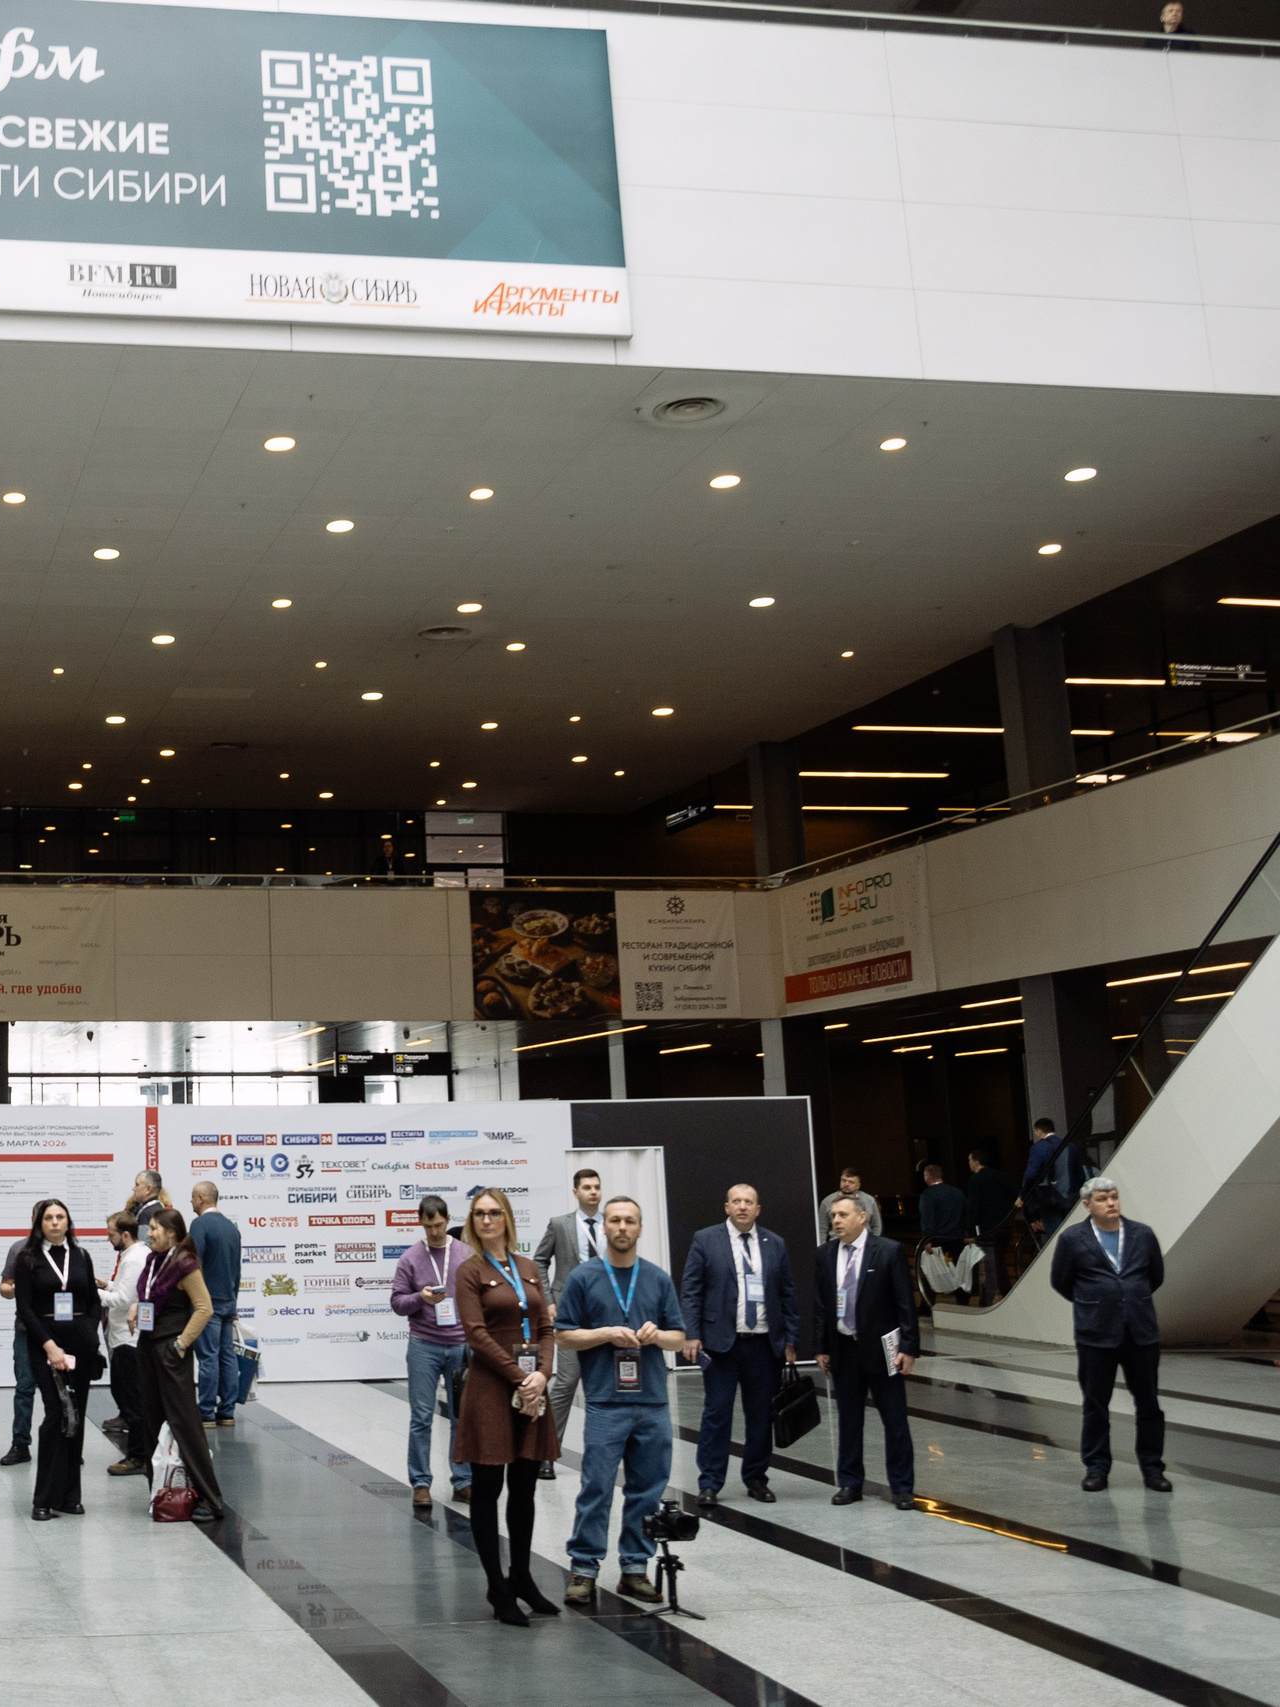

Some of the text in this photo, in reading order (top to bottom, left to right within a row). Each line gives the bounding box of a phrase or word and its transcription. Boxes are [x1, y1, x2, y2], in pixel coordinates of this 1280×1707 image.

[53, 167, 226, 206] СИБИРИ
[249, 273, 418, 304] НОВАЯ СИБИРЬ
[484, 282, 619, 305] АРГУМЕНТЫ
[81, 287, 164, 302] Новосибирск
[621, 940, 734, 950] РЕСТОРАН ТРАДИЦИОННОЙ
[643, 951, 715, 961] И СОВРЕМЕННОЙ
[648, 964, 711, 972] КУХНИ СИБИРИ
[808, 959, 908, 994] ТОЛЬКО ВАЖНЫЕ НОВОСТИ
[10, 985, 33, 995] где
[36, 983, 82, 996] удобно
[265, 1135, 277, 1144] 24
[283, 1135, 332, 1144] СИБИРЬ 24
[338, 1135, 386, 1143] ВЕСТИНСК.РФ
[489, 1132, 514, 1140] МИР
[148, 1124, 157, 1171] СТАВКИ
[243, 1157, 265, 1172] 54
[320, 1160, 366, 1169] ТЕХСОВЕТ
[414, 1161, 450, 1170] Status
[454, 1158, 528, 1166] status-media.com
[371, 1162, 410, 1173] Сиб.фм
[288, 1193, 338, 1203] СИБИРИ
[346, 1189, 392, 1200] СИБИРЬ
[248, 1217, 267, 1228] ЧС
[310, 1215, 374, 1225] ТОЧКА ОПОРЫ
[251, 1252, 286, 1261] РОССИЯ
[335, 1252, 377, 1260] РОССИИ
[303, 1276, 351, 1287] ГОРНЫЙ
[279, 1306, 315, 1316] elec.ru
[376, 1331, 410, 1340] MetalR
